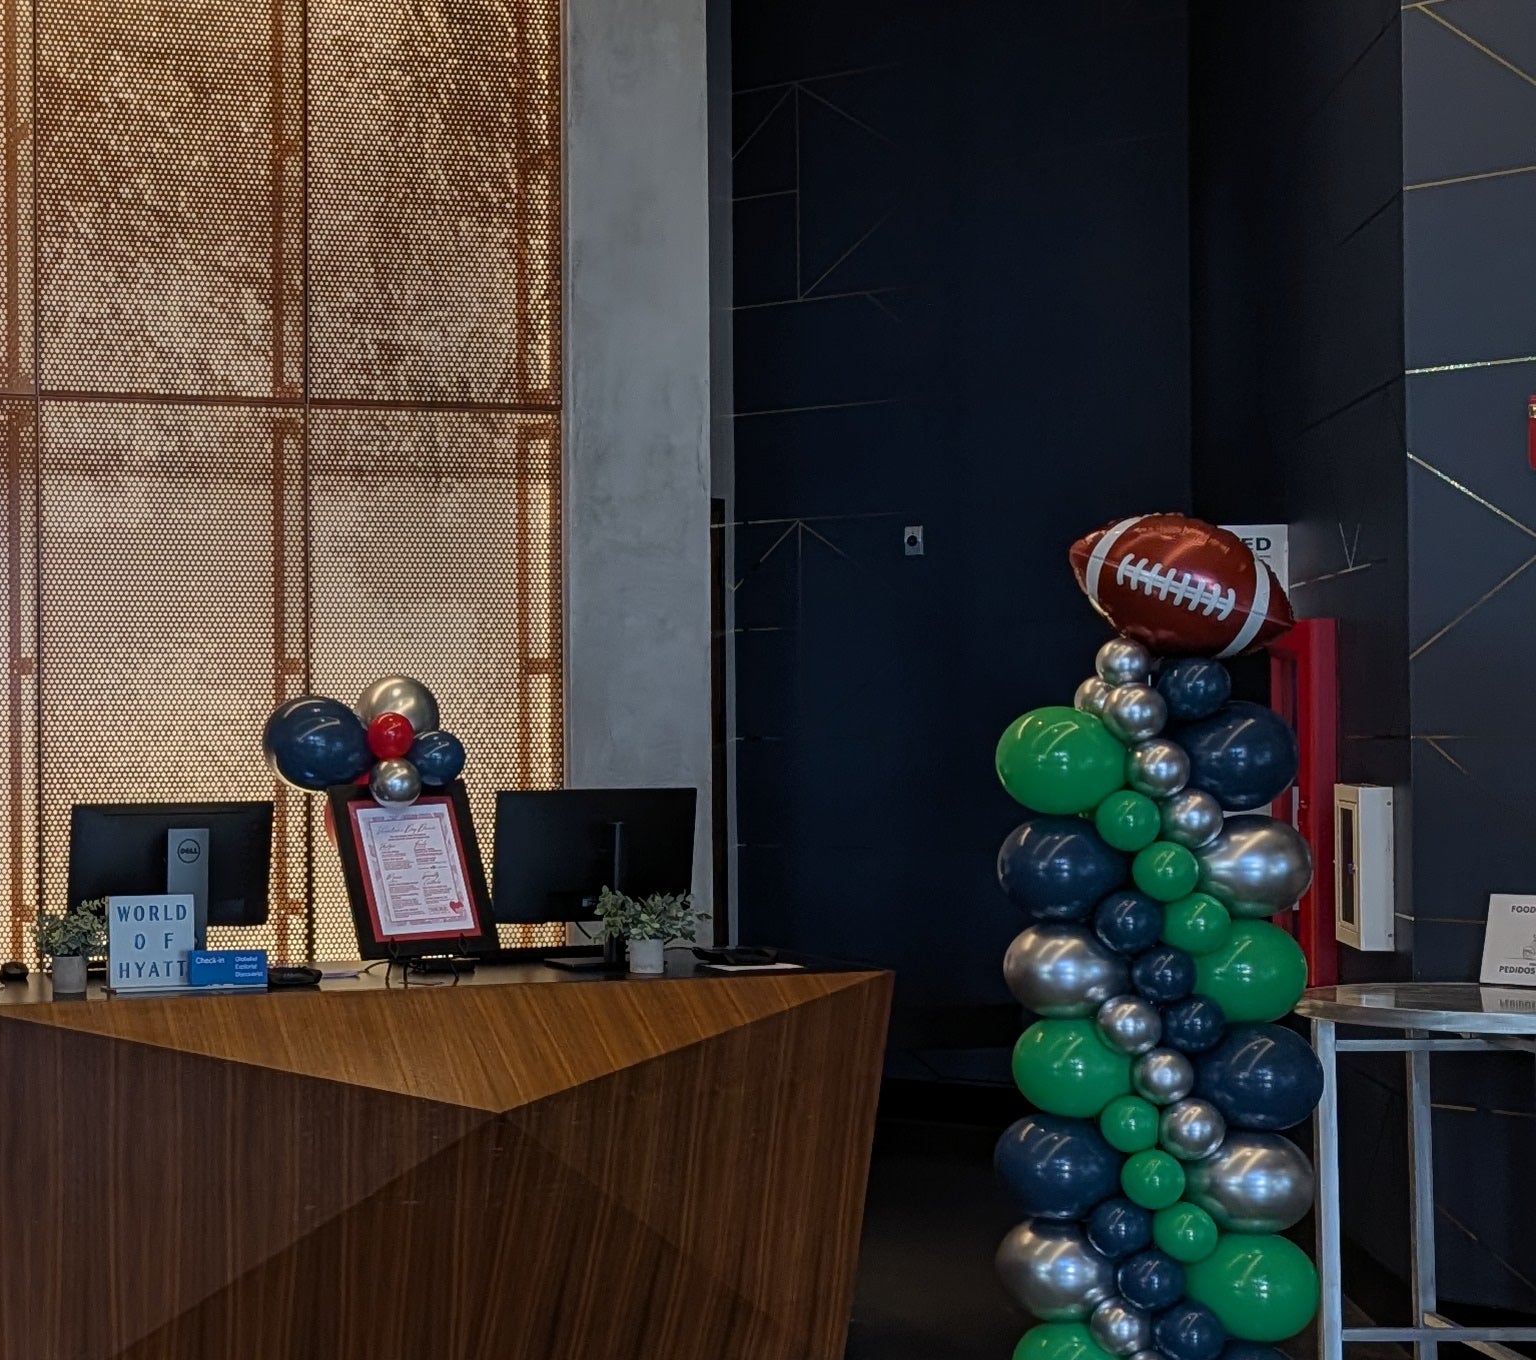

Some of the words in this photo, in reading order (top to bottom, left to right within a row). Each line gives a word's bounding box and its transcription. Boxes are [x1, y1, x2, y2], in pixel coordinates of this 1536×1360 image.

[117, 904, 187, 922] WORLD
[1511, 905, 1536, 913] FOOD
[134, 932, 175, 950] OF
[119, 960, 187, 979] HYATT
[1499, 966, 1536, 974] PEDIDOS
